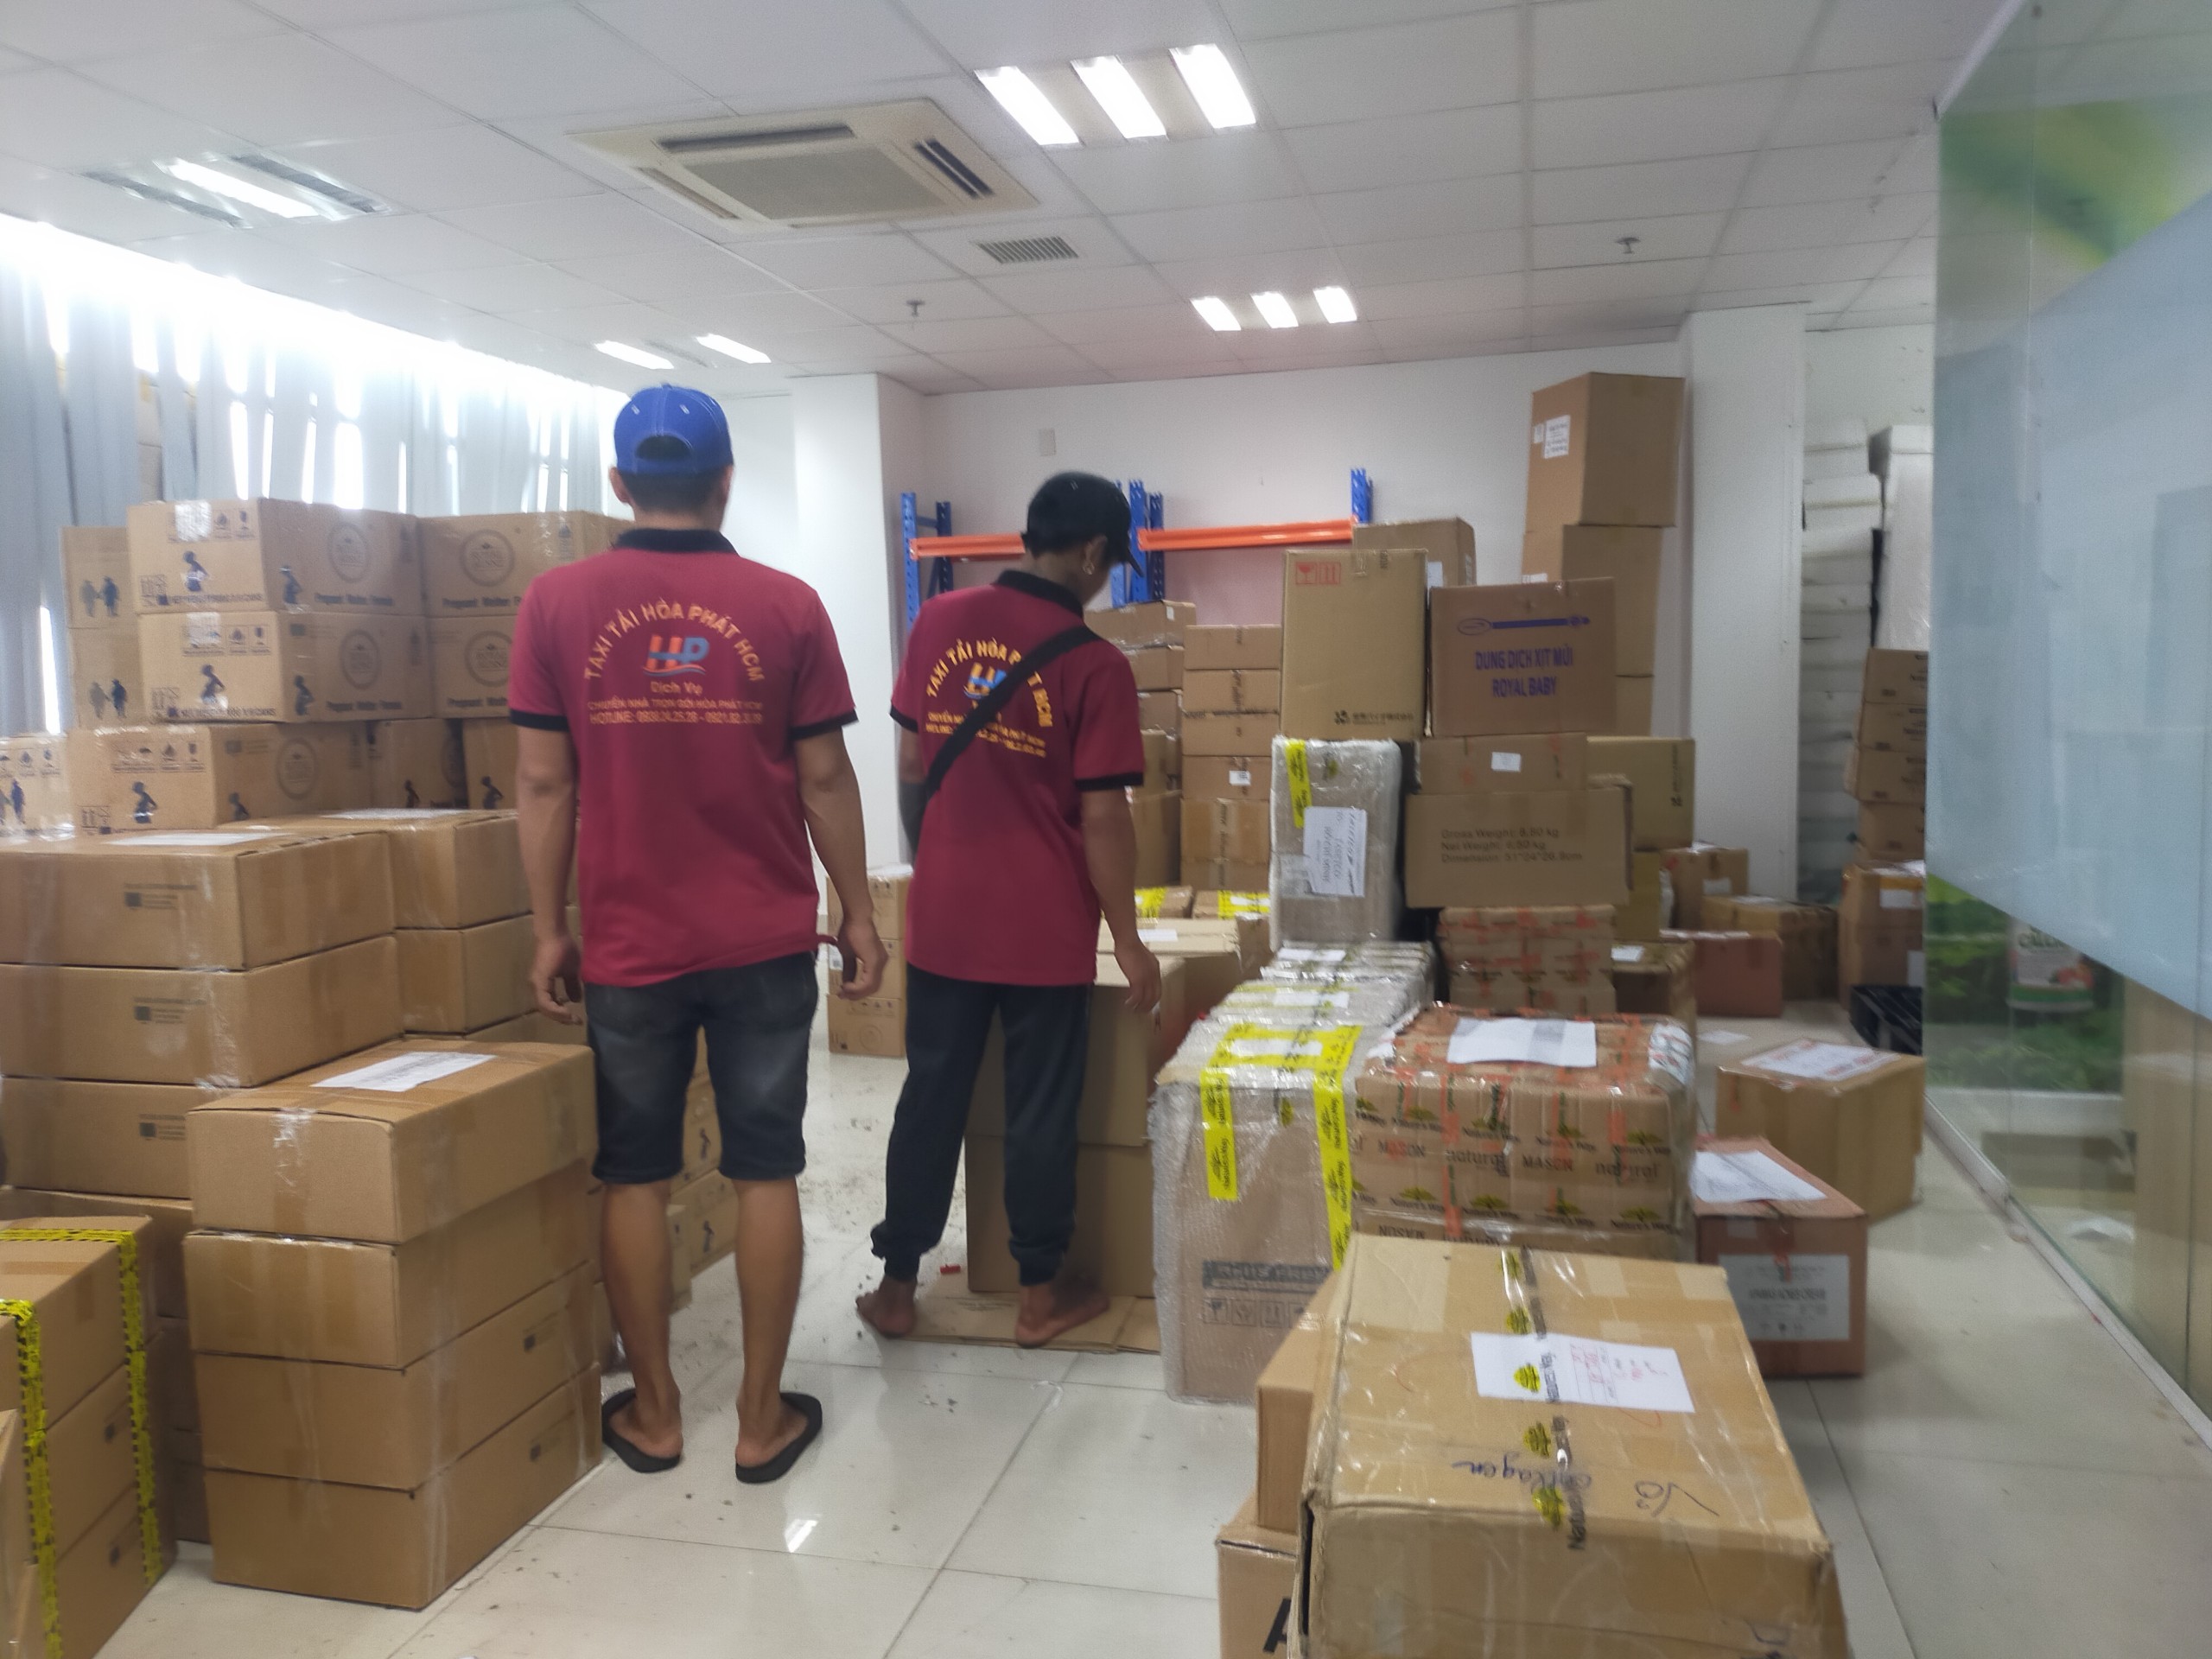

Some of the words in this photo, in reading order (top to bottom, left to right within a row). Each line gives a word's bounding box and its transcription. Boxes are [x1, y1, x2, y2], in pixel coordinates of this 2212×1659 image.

[584, 633, 613, 680] TAXI
[639, 595, 683, 622] HÒA
[686, 602, 742, 639] PHÁT
[733, 638, 766, 682] HCM
[646, 633, 710, 670] HP
[1475, 650, 1506, 671] DUNG
[1508, 649, 1532, 672] DỊCH
[925, 658, 950, 699] TAXI
[1491, 678, 1527, 697] ROYAL
[1529, 676, 1557, 697] BABY
[1440, 829, 1472, 839] Gross
[1440, 842, 1460, 851] Net
[1522, 1154, 1573, 1172] MASON
